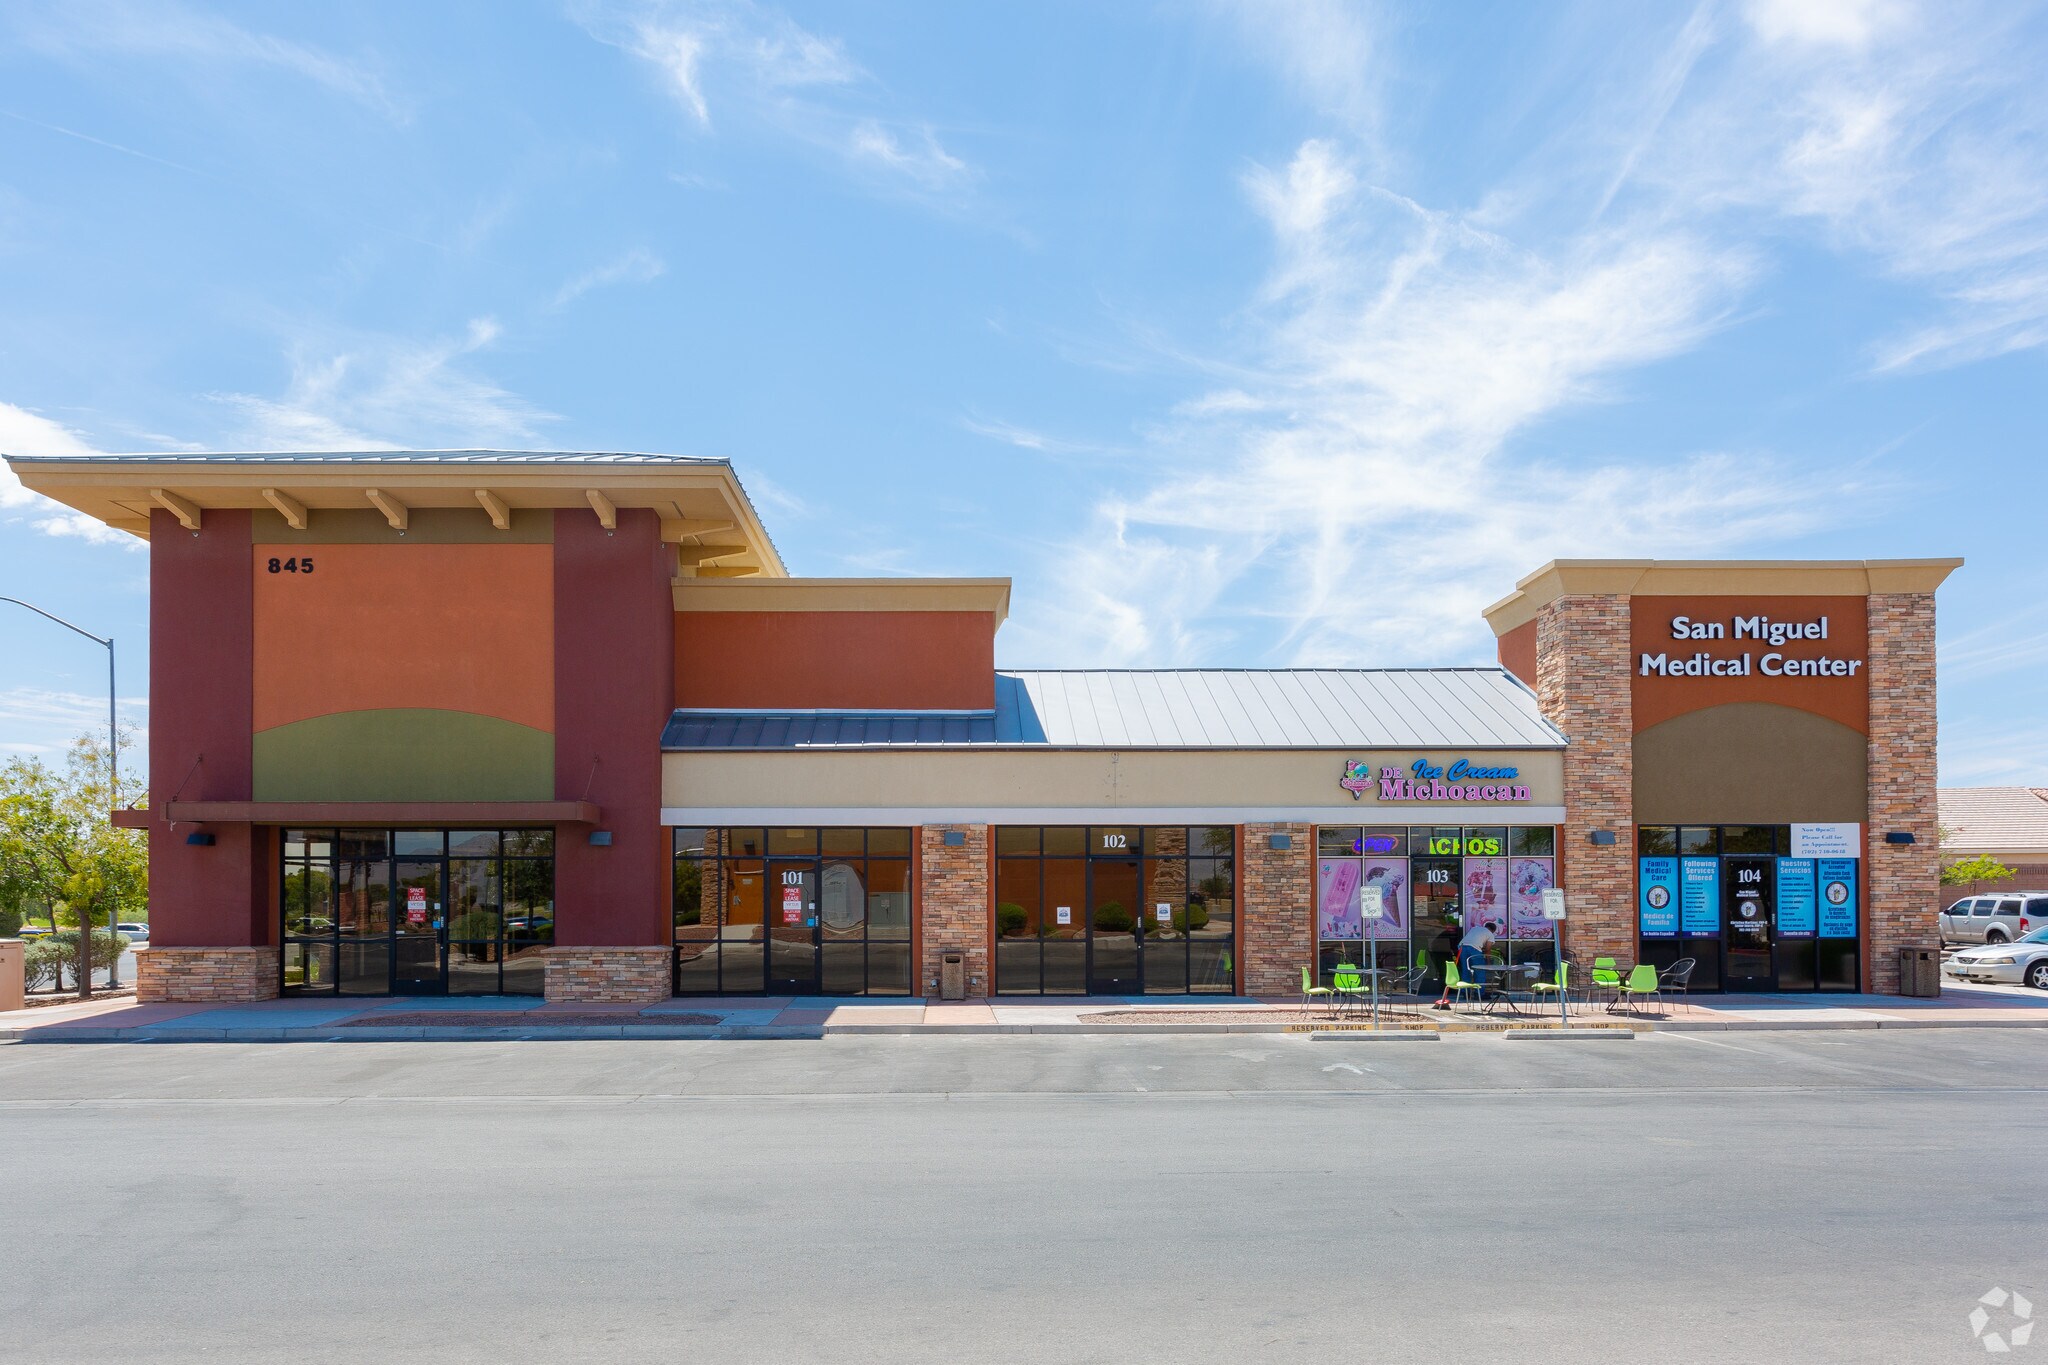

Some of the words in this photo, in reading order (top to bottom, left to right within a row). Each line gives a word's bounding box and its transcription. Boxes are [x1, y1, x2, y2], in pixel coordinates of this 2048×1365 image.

[268, 558, 314, 573] 845
[1672, 616, 1724, 639] San
[1734, 616, 1828, 646] Miguel
[1641, 653, 1750, 676] Medical
[1760, 653, 1862, 676] Center
[1381, 767, 1403, 778] DE
[1411, 759, 1444, 779] Ice
[1447, 758, 1519, 781] Cream
[1378, 779, 1532, 800] Michoacan
[1103, 834, 1126, 848] 102
[781, 871, 804, 885] 101
[1426, 869, 1449, 883] 103
[1738, 869, 1761, 882] 104
